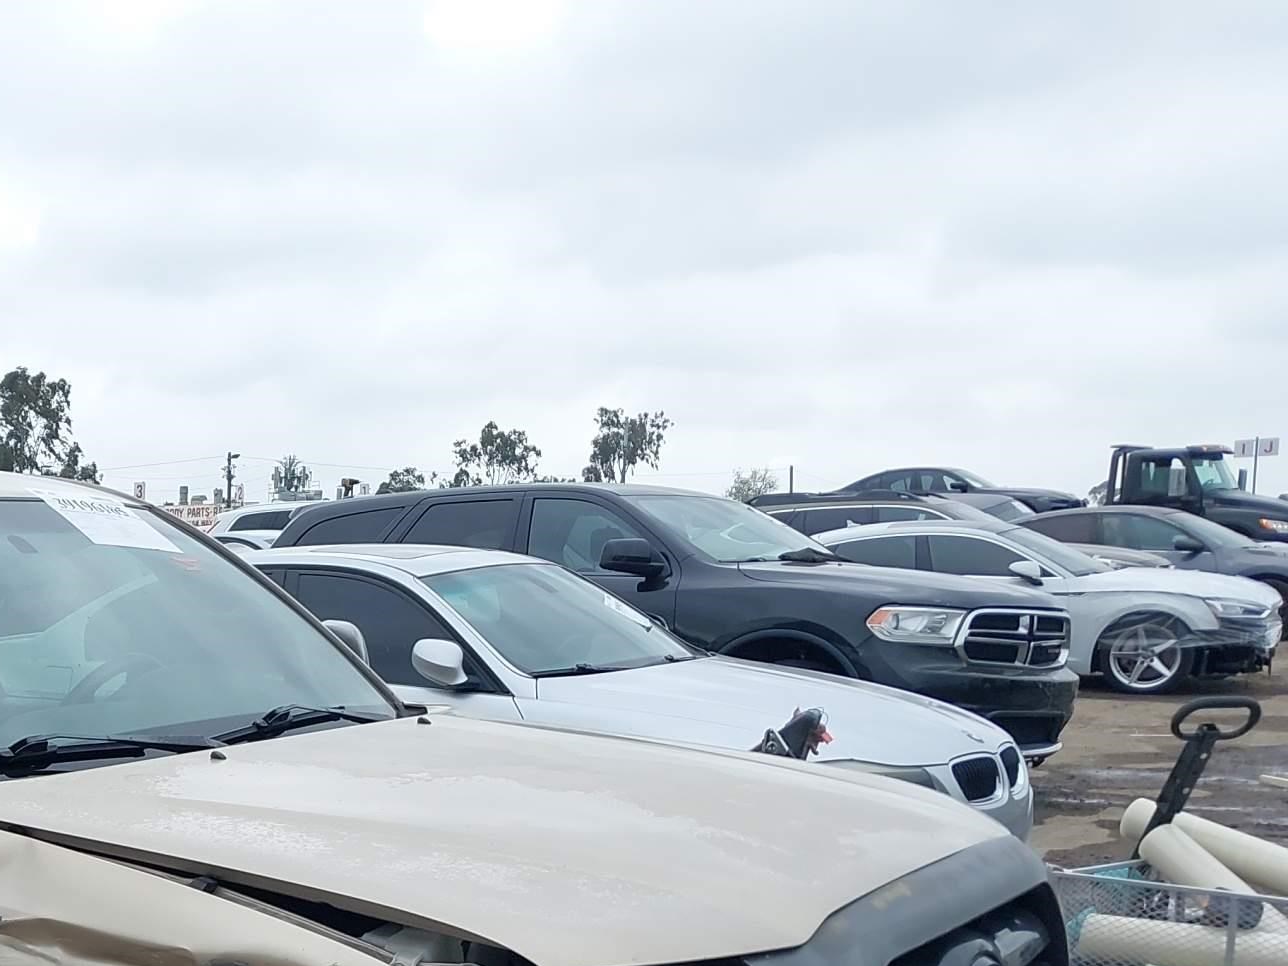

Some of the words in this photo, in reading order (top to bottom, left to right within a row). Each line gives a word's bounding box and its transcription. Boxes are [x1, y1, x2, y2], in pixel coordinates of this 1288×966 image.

[1263, 440, 1274, 453] J
[135, 484, 143, 499] 3
[165, 508, 185, 518] ODY
